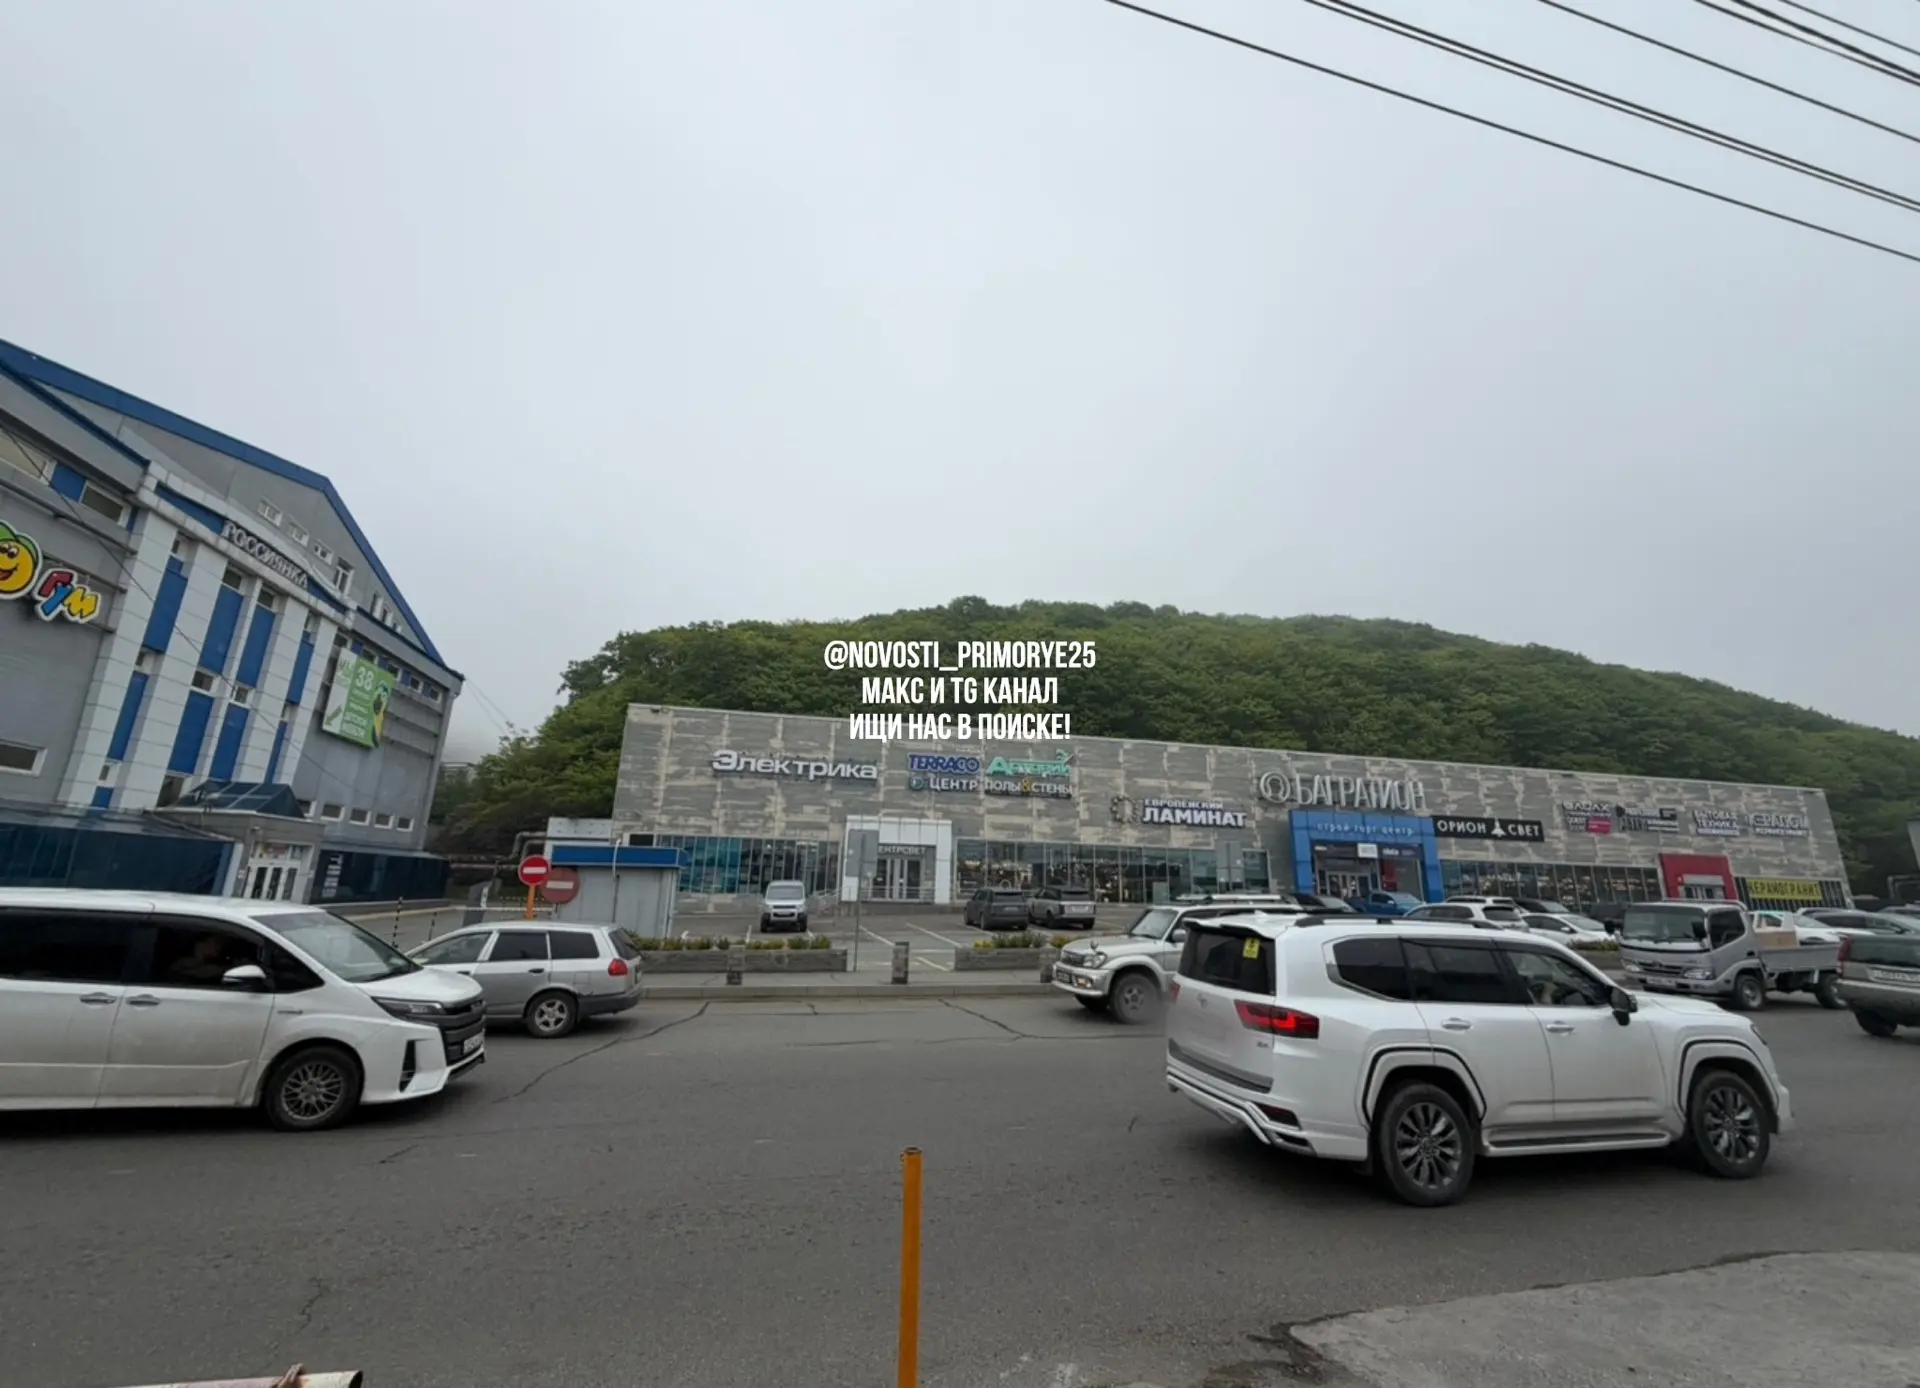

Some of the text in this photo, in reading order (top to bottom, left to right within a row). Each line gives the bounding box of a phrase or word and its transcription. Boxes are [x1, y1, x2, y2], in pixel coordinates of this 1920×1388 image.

[222, 520, 308, 589] РОССИЯНКА
[355, 666, 374, 691] 38
[712, 750, 878, 780] Электрика
[909, 753, 981, 773] TERRACO
[929, 777, 978, 791] ЦЕНТР
[1296, 773, 1427, 811] БАГРАТИОН
[1143, 807, 1247, 827] ЛАМИНАТ
[1437, 820, 1539, 836] ОРИОН СВЕТ
[878, 845, 927, 856] ЕНТРСВЕТ
